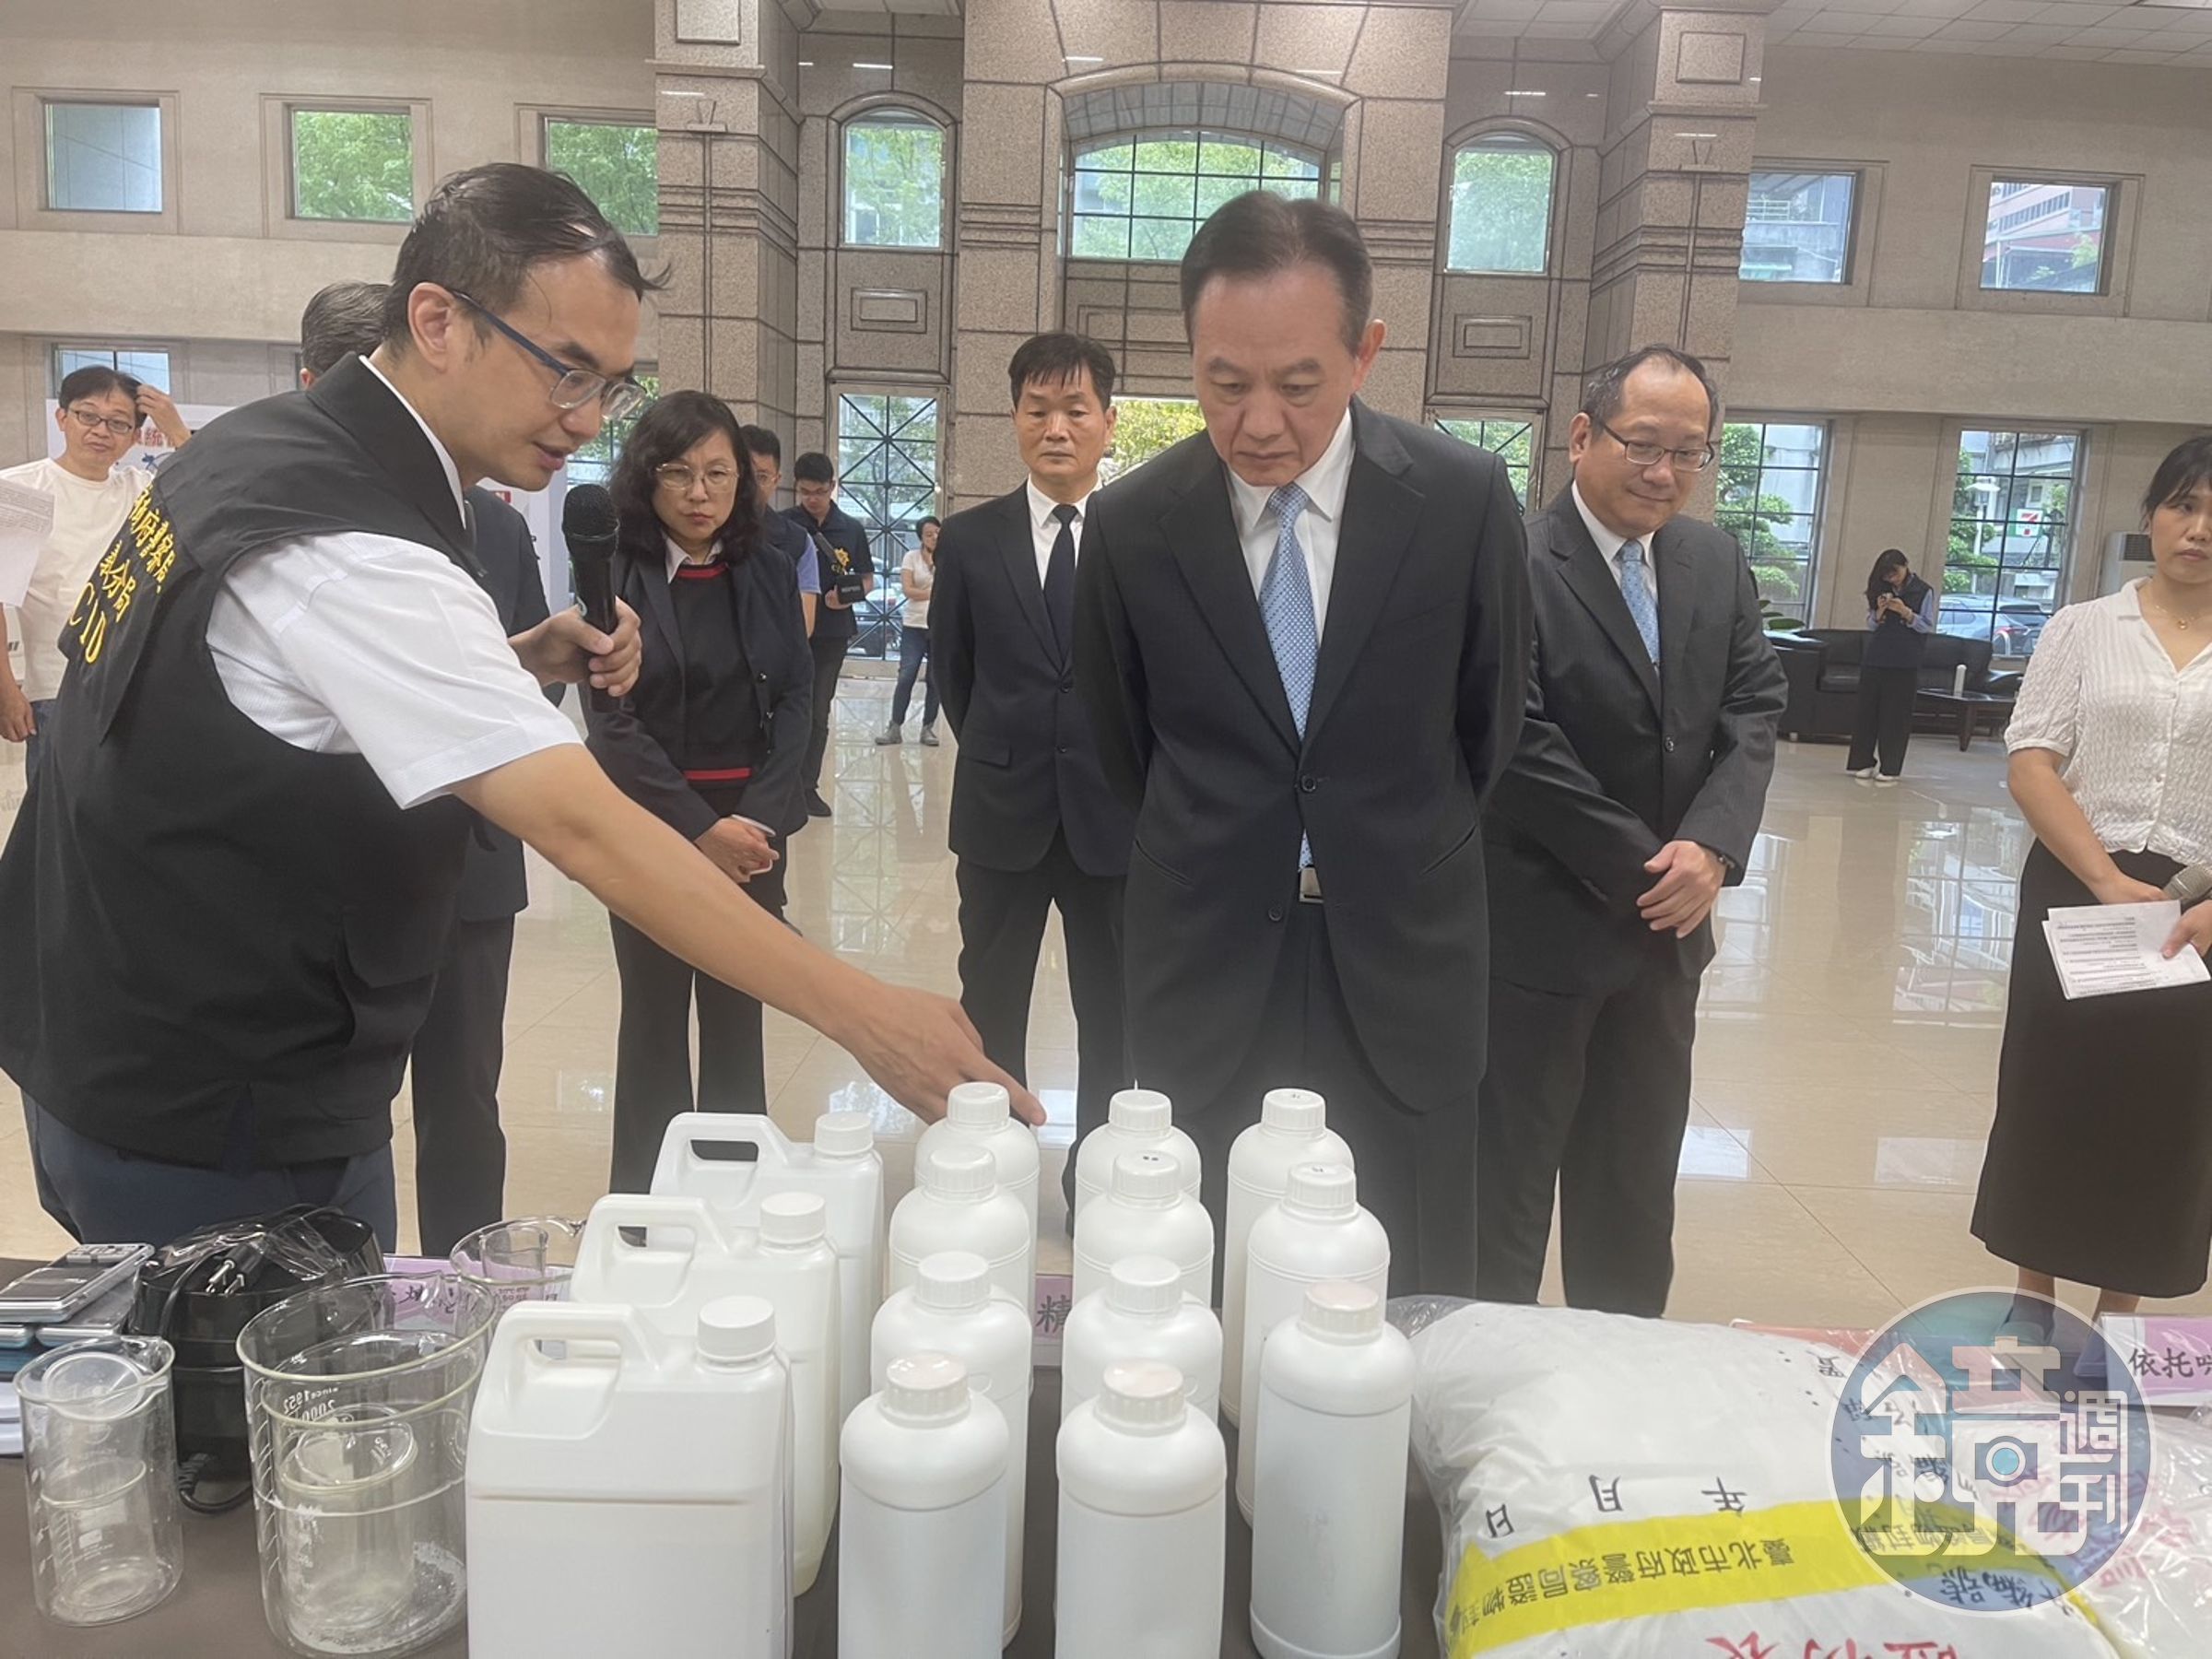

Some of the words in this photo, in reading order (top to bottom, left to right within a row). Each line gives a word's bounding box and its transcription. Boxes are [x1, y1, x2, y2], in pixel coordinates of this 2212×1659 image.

[69, 582, 108, 664] CID
[1588, 1475, 1623, 1512] 月
[1701, 1477, 1747, 1517] 年
[1485, 1503, 1515, 1538] 日
